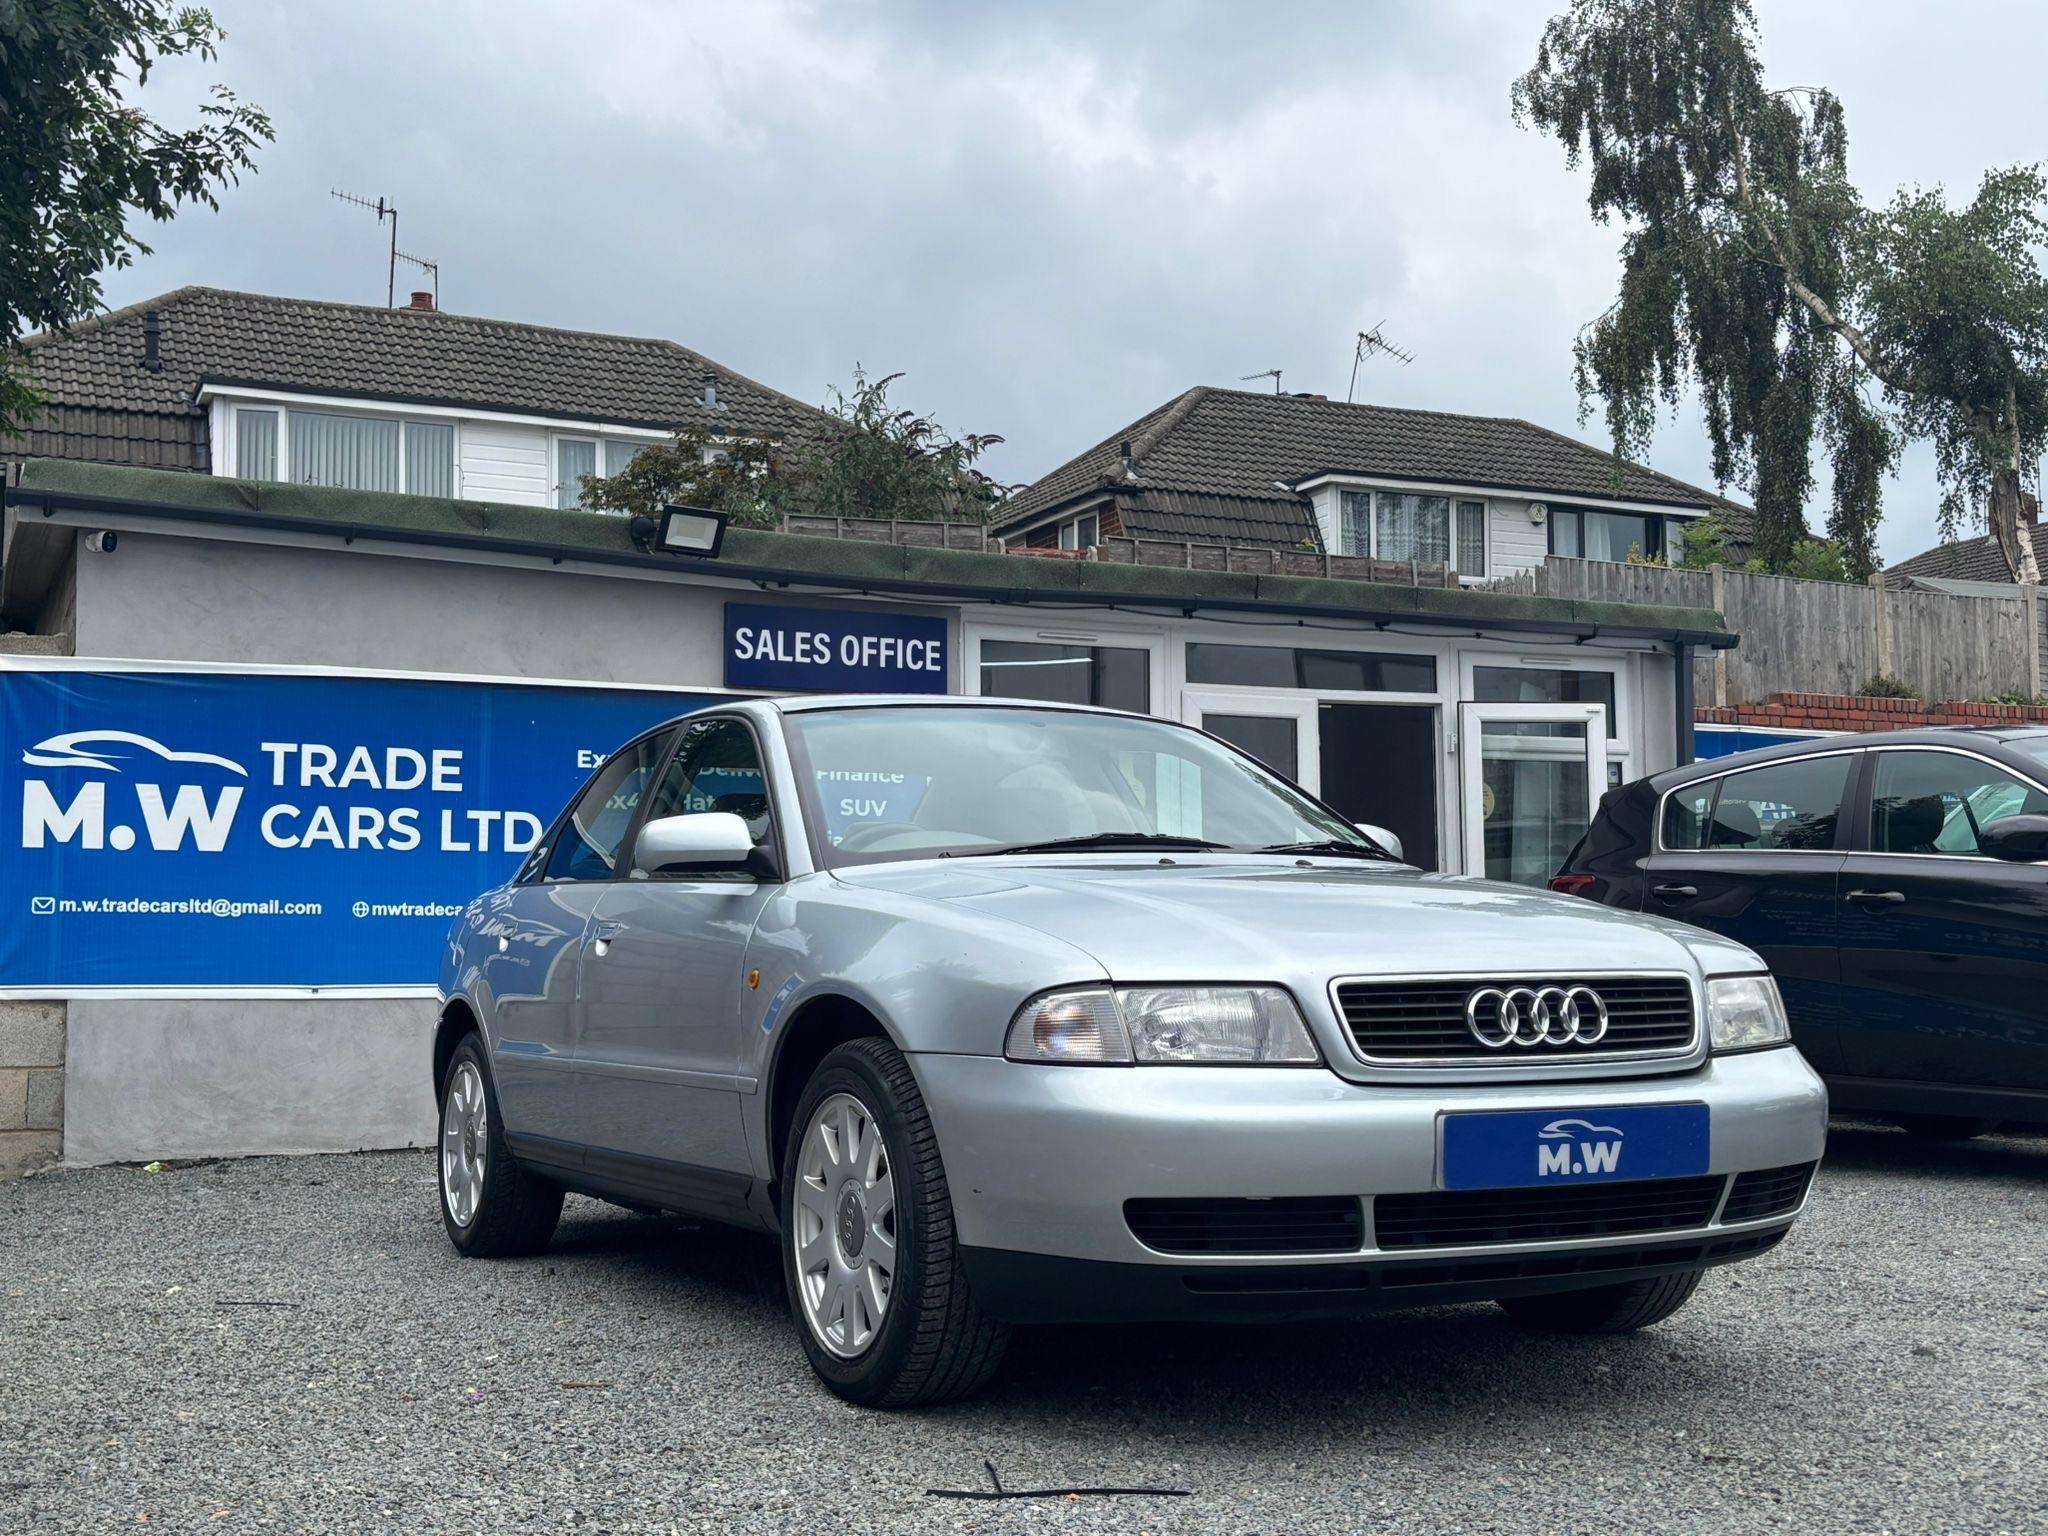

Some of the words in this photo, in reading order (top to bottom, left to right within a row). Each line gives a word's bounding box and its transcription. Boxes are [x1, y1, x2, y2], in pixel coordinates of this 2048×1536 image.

[735, 627, 831, 665] SALES
[840, 634, 941, 671] OFFICE
[261, 742, 463, 792] TRADE
[22, 779, 245, 852] M.W
[260, 803, 421, 851] CARS
[440, 809, 543, 853] LTD
[840, 798, 888, 817] SUV
[59, 898, 322, 918] m.w.tradecarsltd@gmail.com
[1538, 1140, 1622, 1177] M.W
